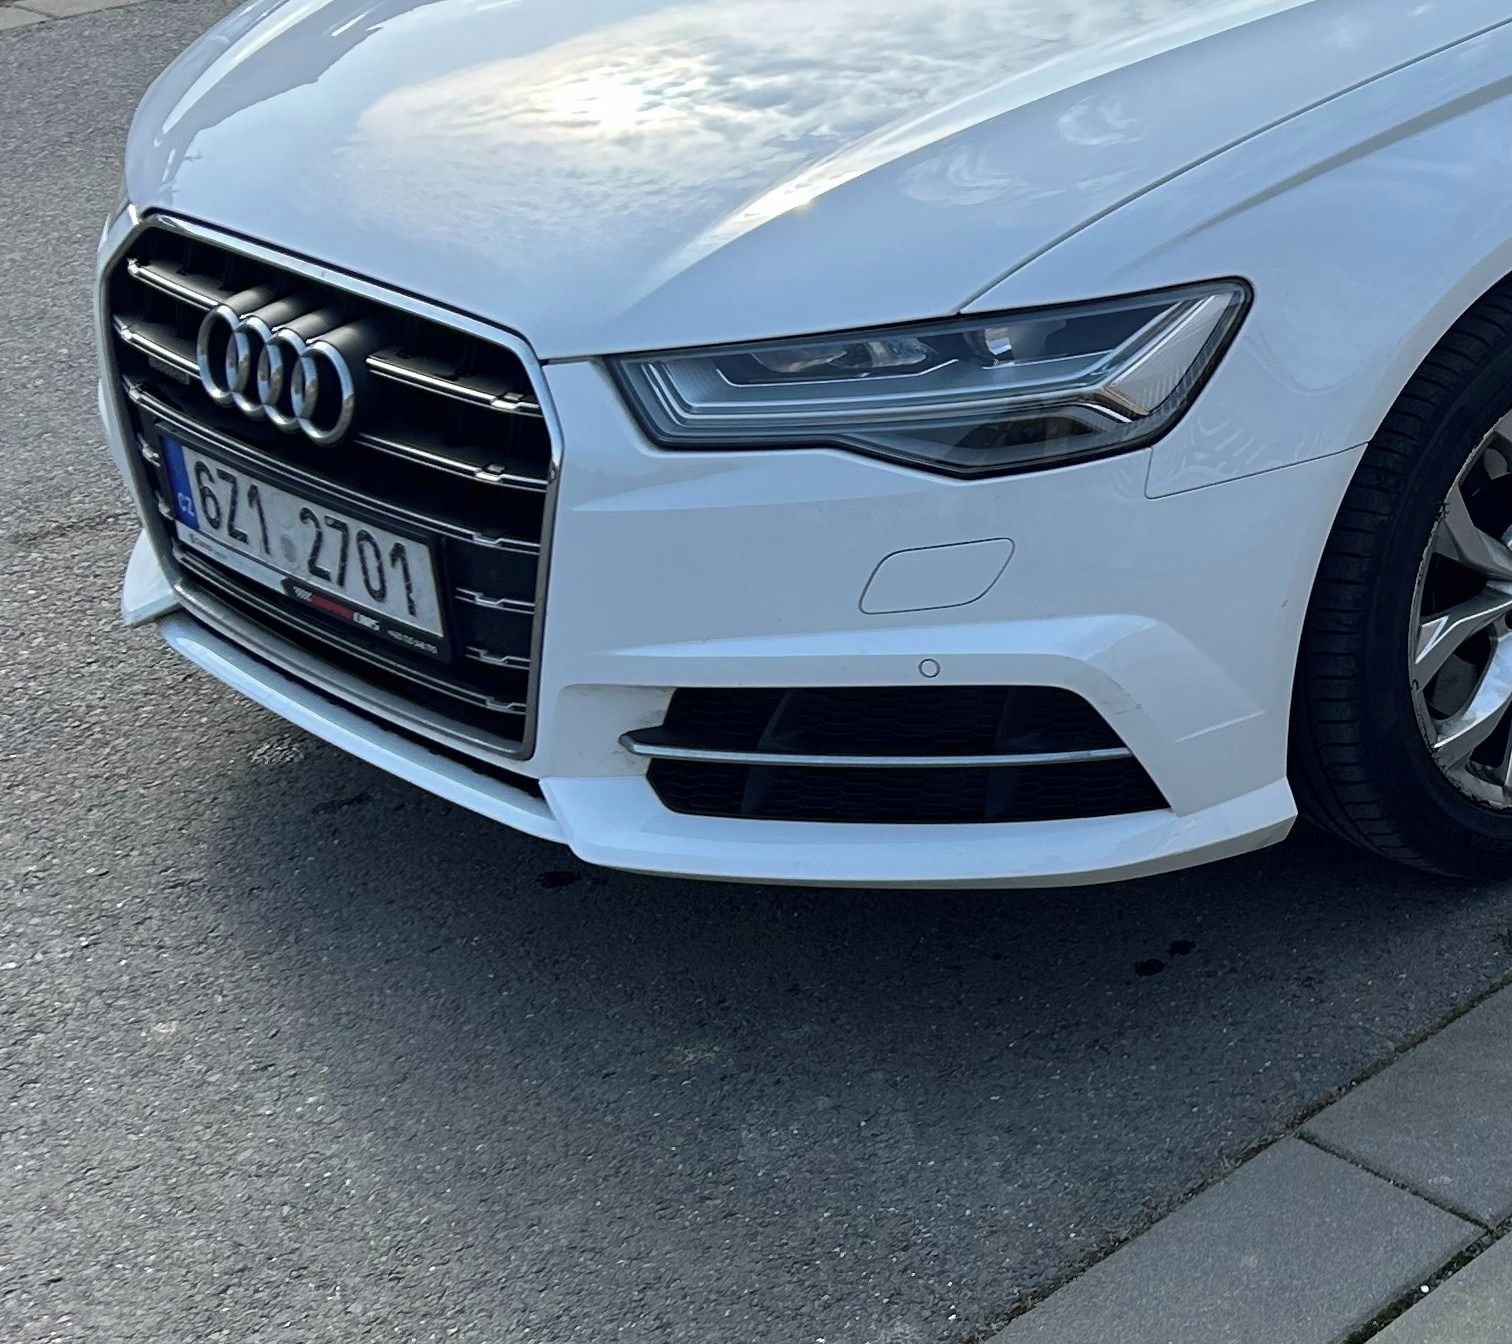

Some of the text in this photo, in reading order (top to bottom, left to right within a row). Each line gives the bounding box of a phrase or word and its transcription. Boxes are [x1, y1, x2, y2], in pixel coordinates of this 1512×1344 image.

[178, 491, 195, 517] CZ
[194, 461, 417, 617] 6Z1 2701
